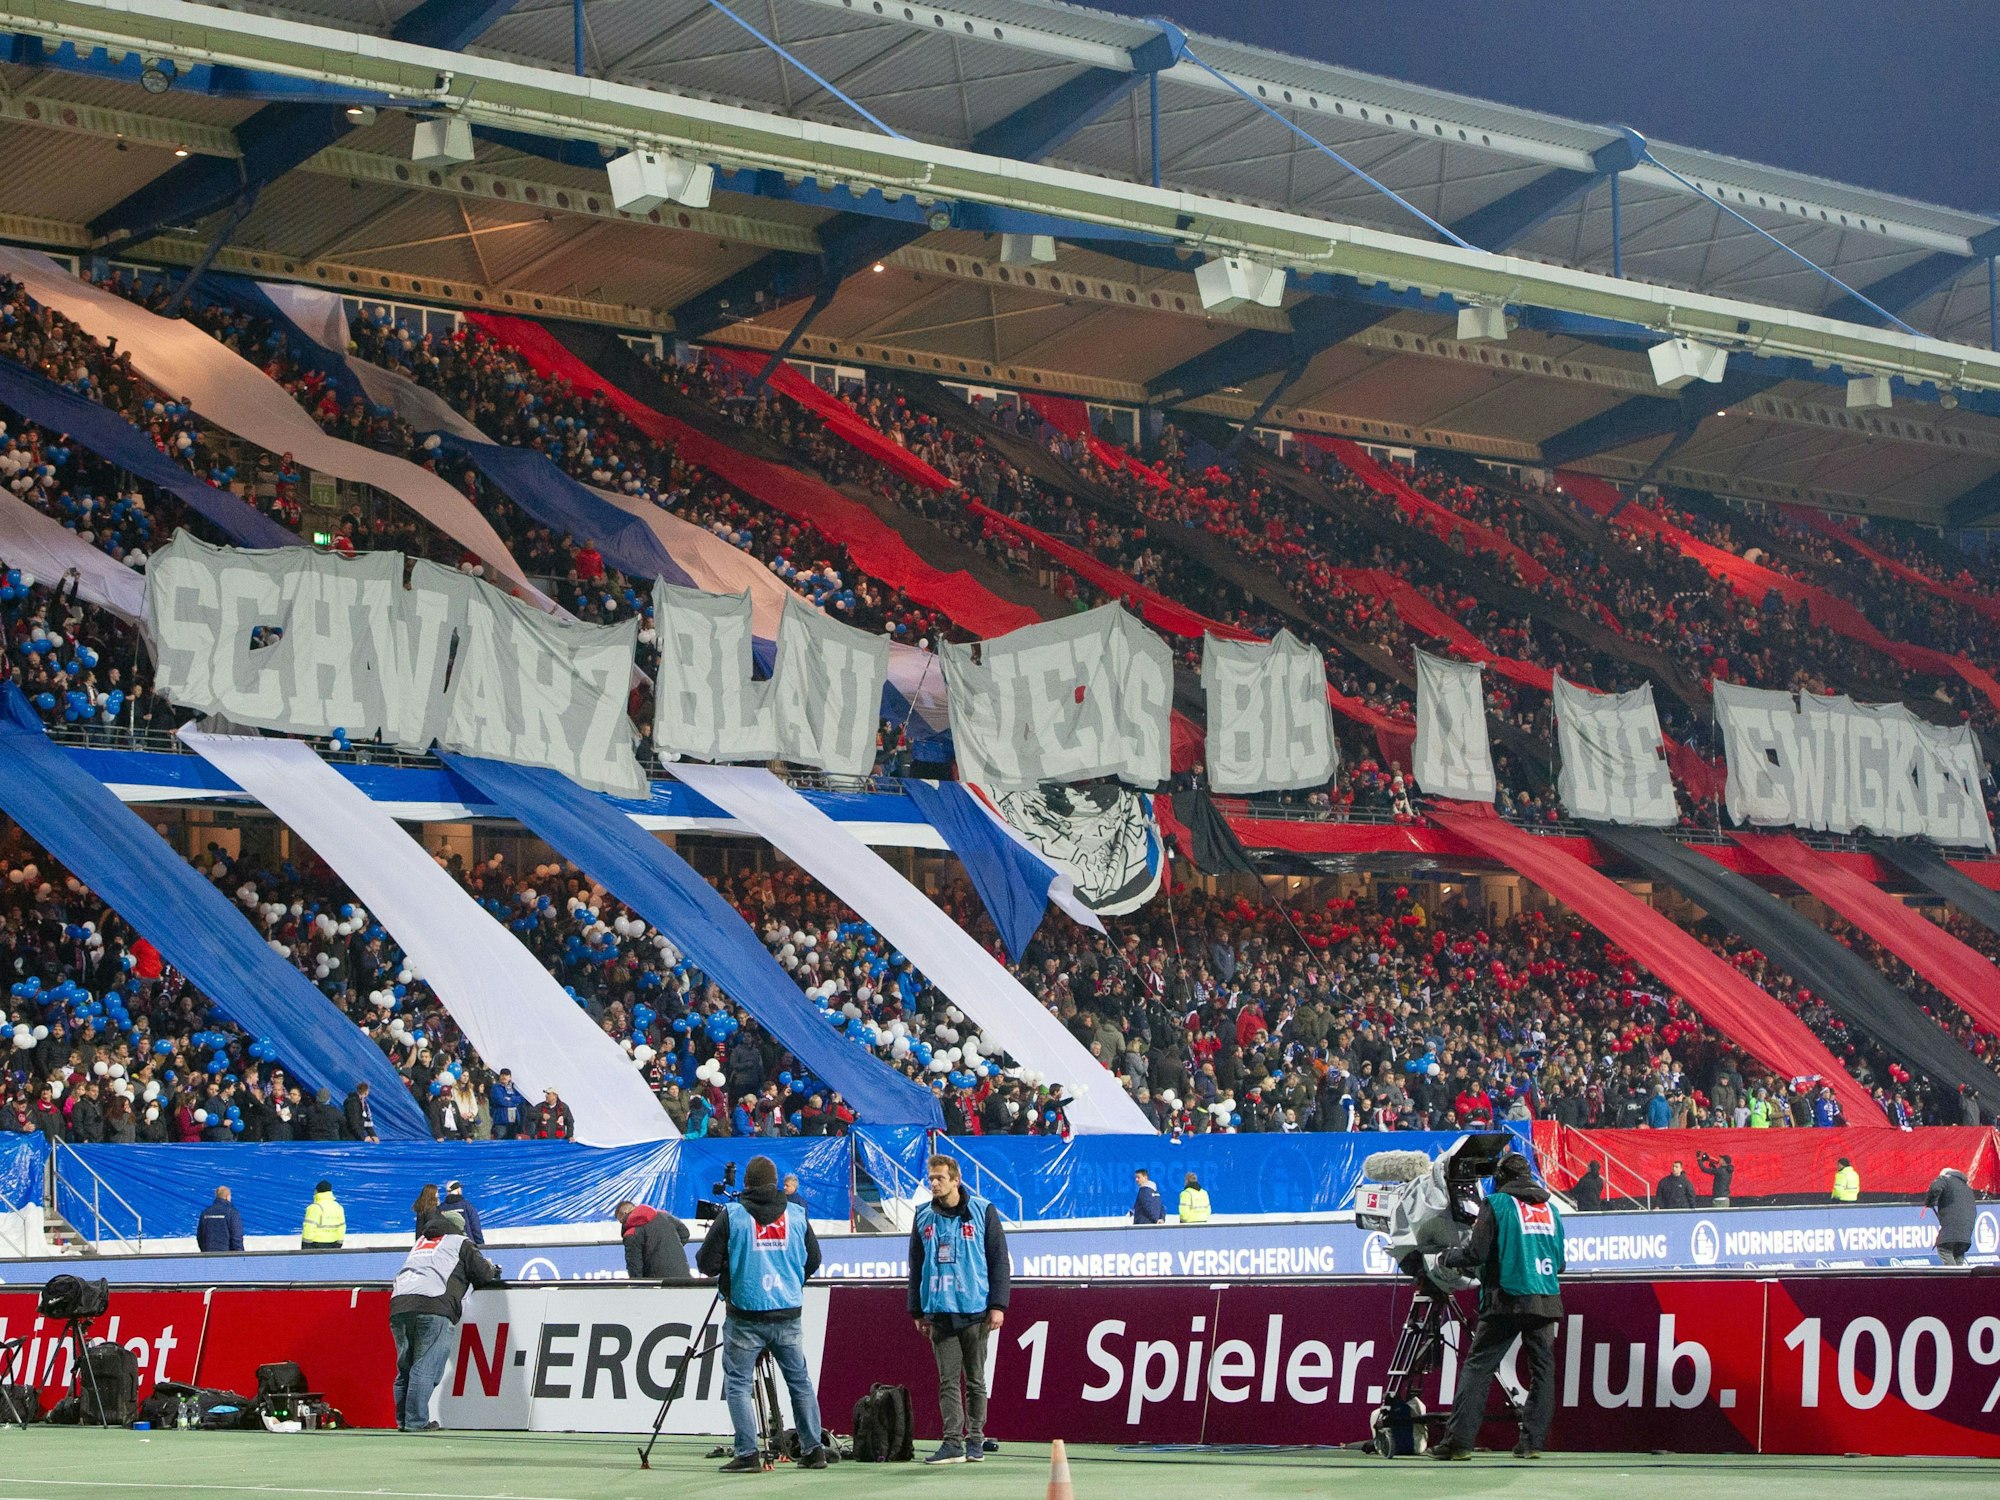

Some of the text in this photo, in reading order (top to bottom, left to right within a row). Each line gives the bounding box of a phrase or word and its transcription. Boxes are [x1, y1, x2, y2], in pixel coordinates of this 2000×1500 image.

[153, 556, 639, 790] SCHWARZ
[657, 601, 875, 780] BLAU
[1214, 652, 1331, 784] BIS
[1563, 703, 1676, 821] DIE
[1023, 1245, 1335, 1278] NÜRNBERGER VERSICHERUNG
[1725, 1229, 1835, 1256] NÜRNBERGER
[1081, 1313, 1382, 1425] Spieler.
